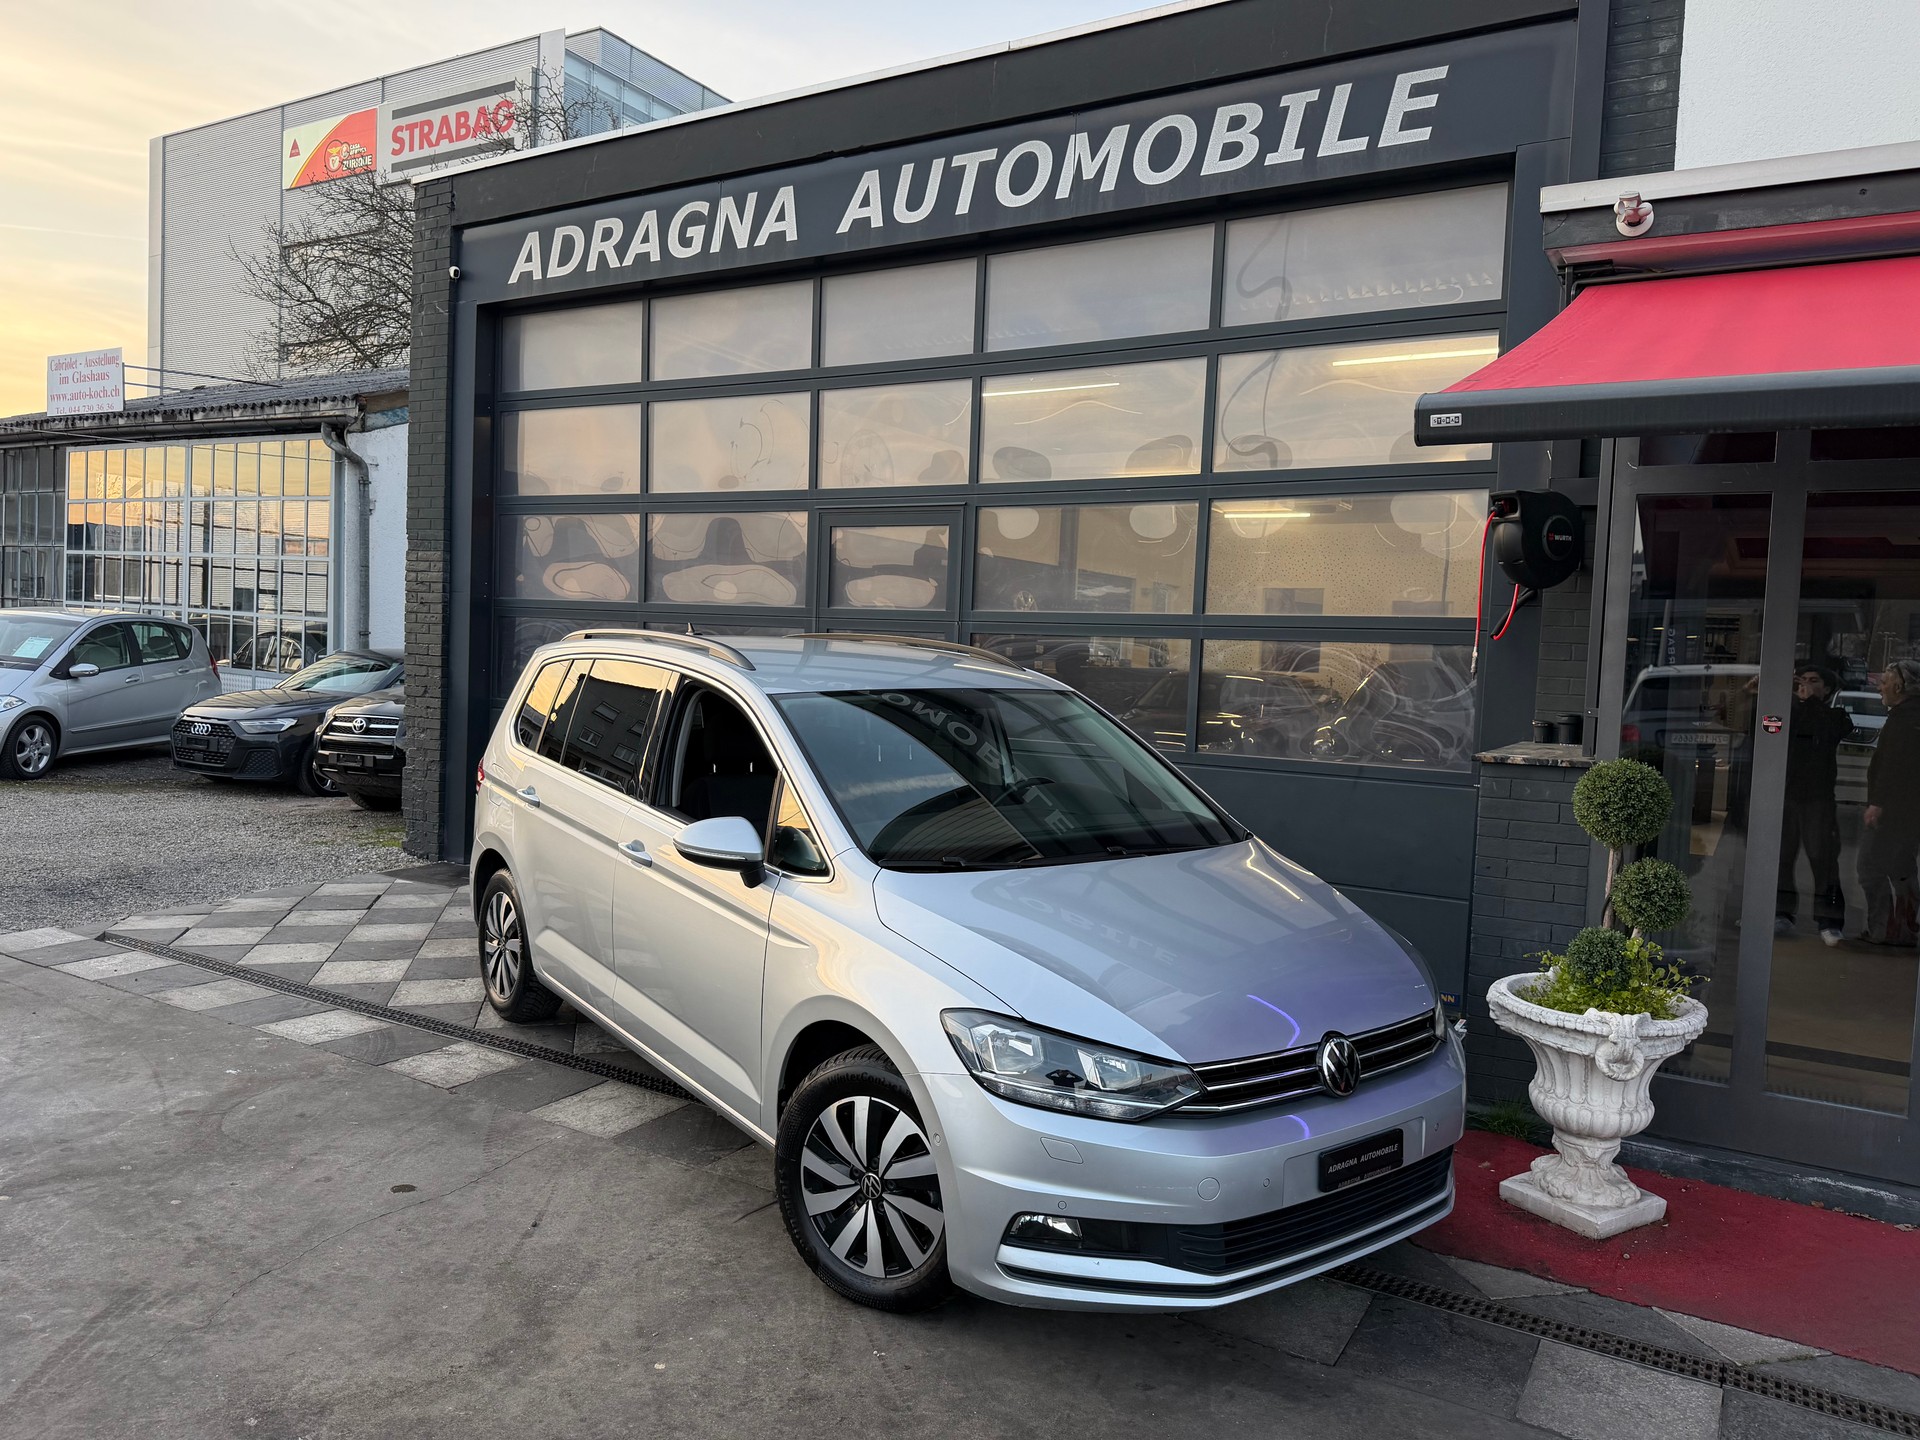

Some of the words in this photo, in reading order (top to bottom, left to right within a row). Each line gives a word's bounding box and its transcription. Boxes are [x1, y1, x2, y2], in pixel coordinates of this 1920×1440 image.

[390, 99, 516, 157] STRABAG
[507, 185, 798, 285] ADRAGNA
[835, 64, 1450, 235] AUTOMOBILE
[50, 357, 78, 372] Cabriolet
[84, 353, 120, 369] Ausstellung
[59, 373, 69, 385] im
[72, 370, 110, 384] Glashaus
[50, 385, 120, 403] www.auto-koch.ch
[55, 407, 66, 415] Tel.
[68, 405, 80, 414] 044
[83, 404, 94, 413] 730
[1327, 1157, 1358, 1174] ADRAGNA
[1360, 1143, 1399, 1163] AUTOMOBILE
